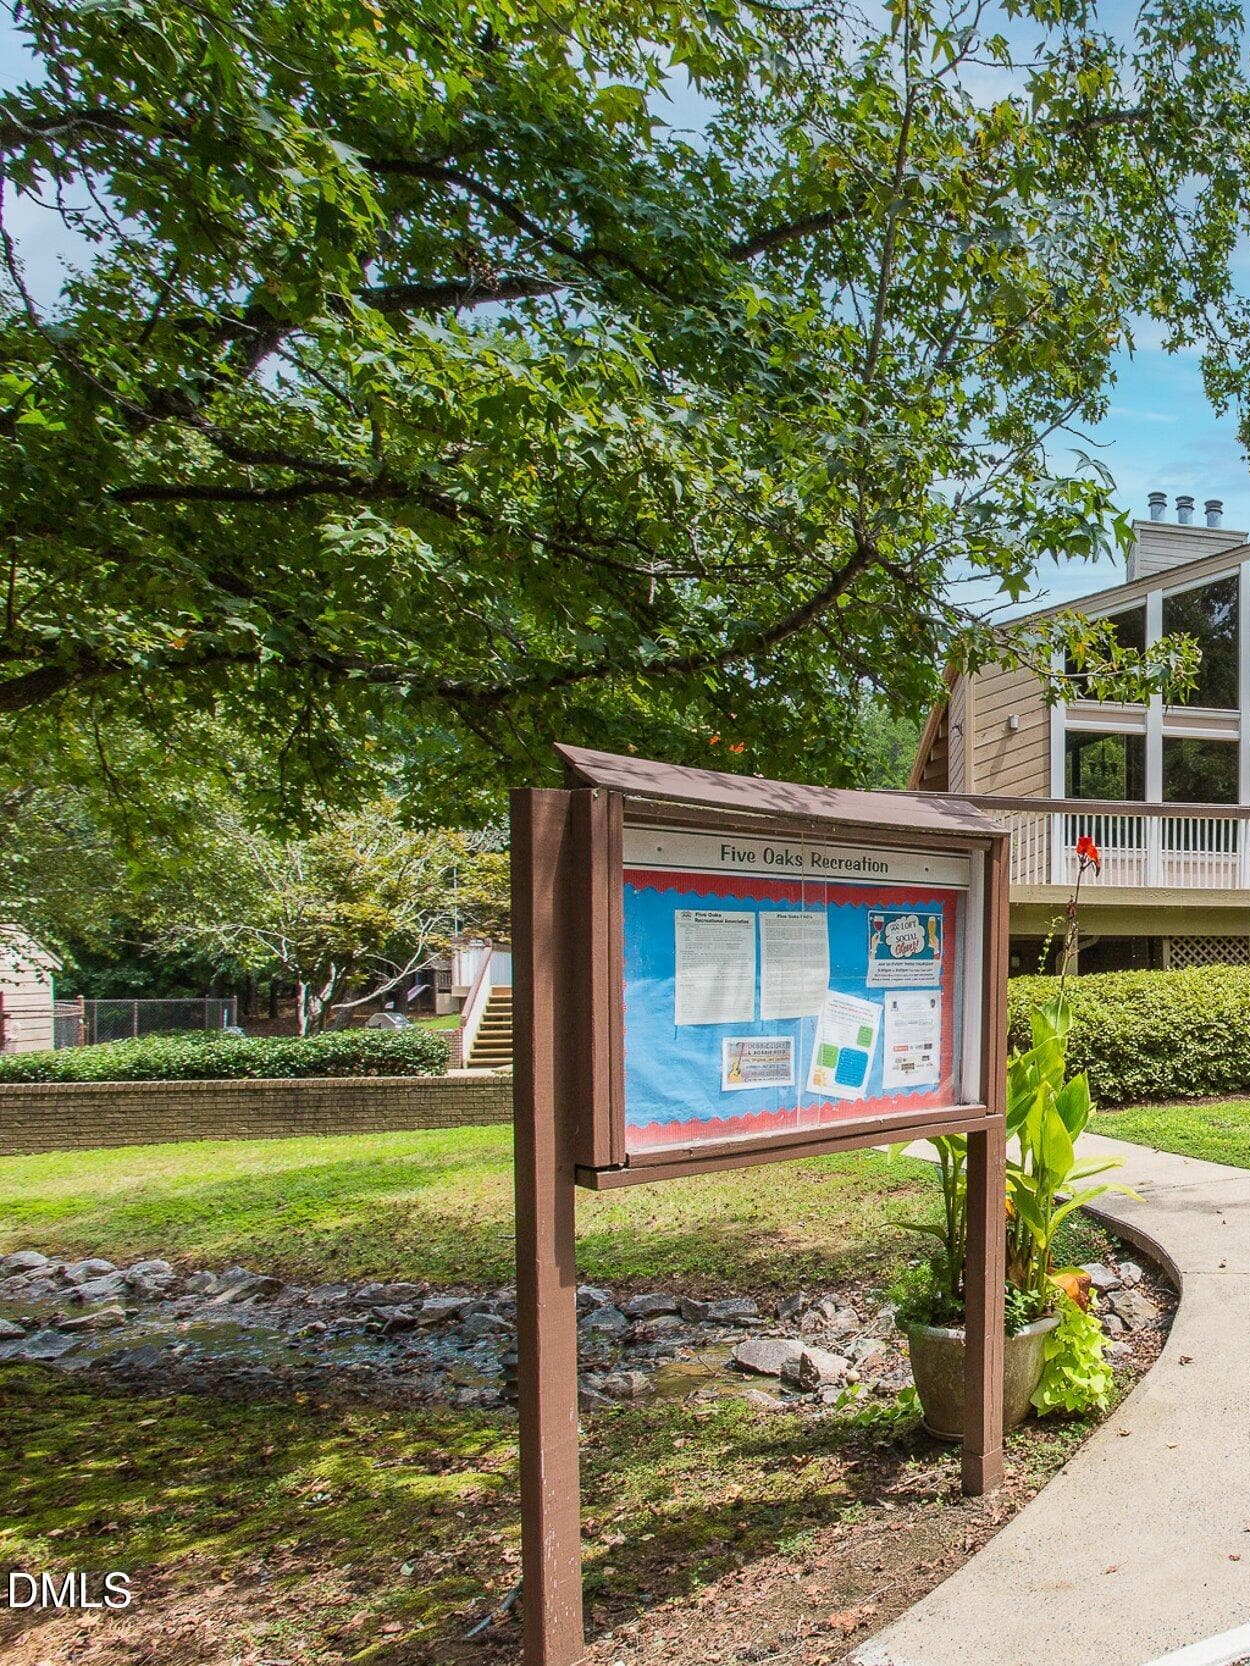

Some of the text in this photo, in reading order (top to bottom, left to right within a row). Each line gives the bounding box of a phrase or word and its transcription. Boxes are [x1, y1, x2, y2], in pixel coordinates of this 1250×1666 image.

[720, 844, 889, 873] Five Oaks Recreation
[900, 920, 917, 930] LOFT
